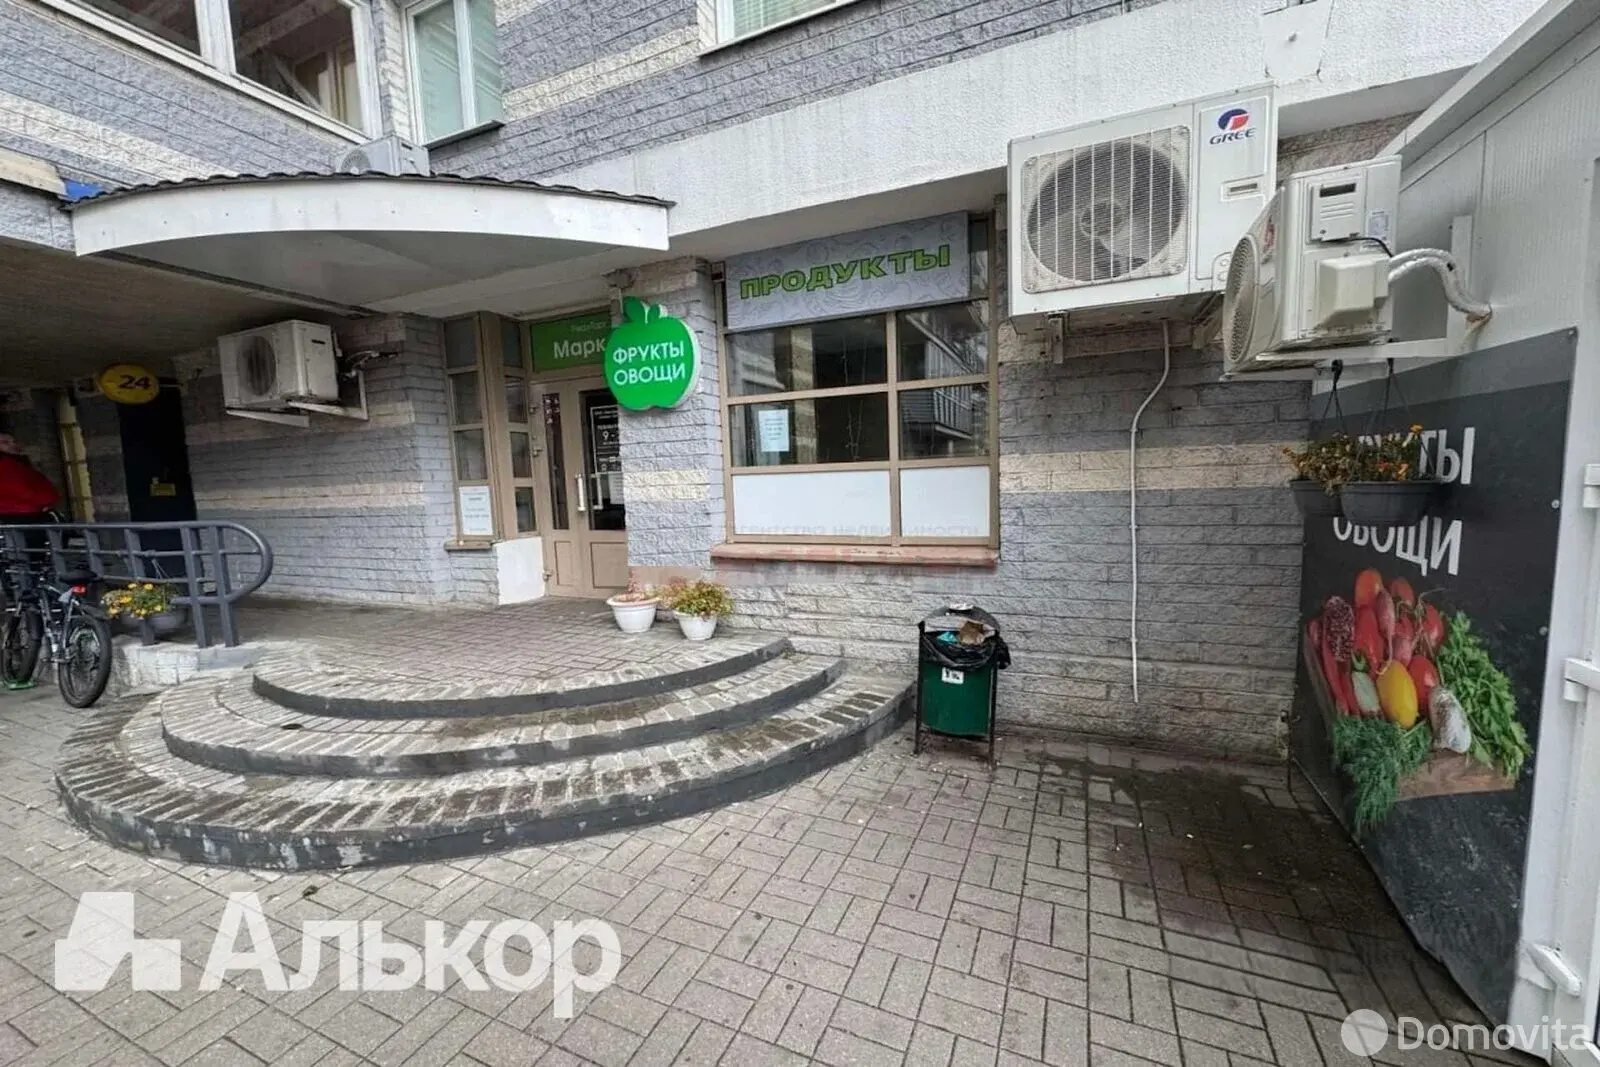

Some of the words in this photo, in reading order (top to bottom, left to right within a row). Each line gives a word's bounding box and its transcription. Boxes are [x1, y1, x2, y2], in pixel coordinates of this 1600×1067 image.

[1209, 127, 1256, 145] GREE
[739, 244, 951, 300] ПРОДУКТЫ
[613, 341, 685, 365] ФРУКТЫ
[119, 375, 151, 390] 24
[614, 364, 685, 385] ОВОЩИ
